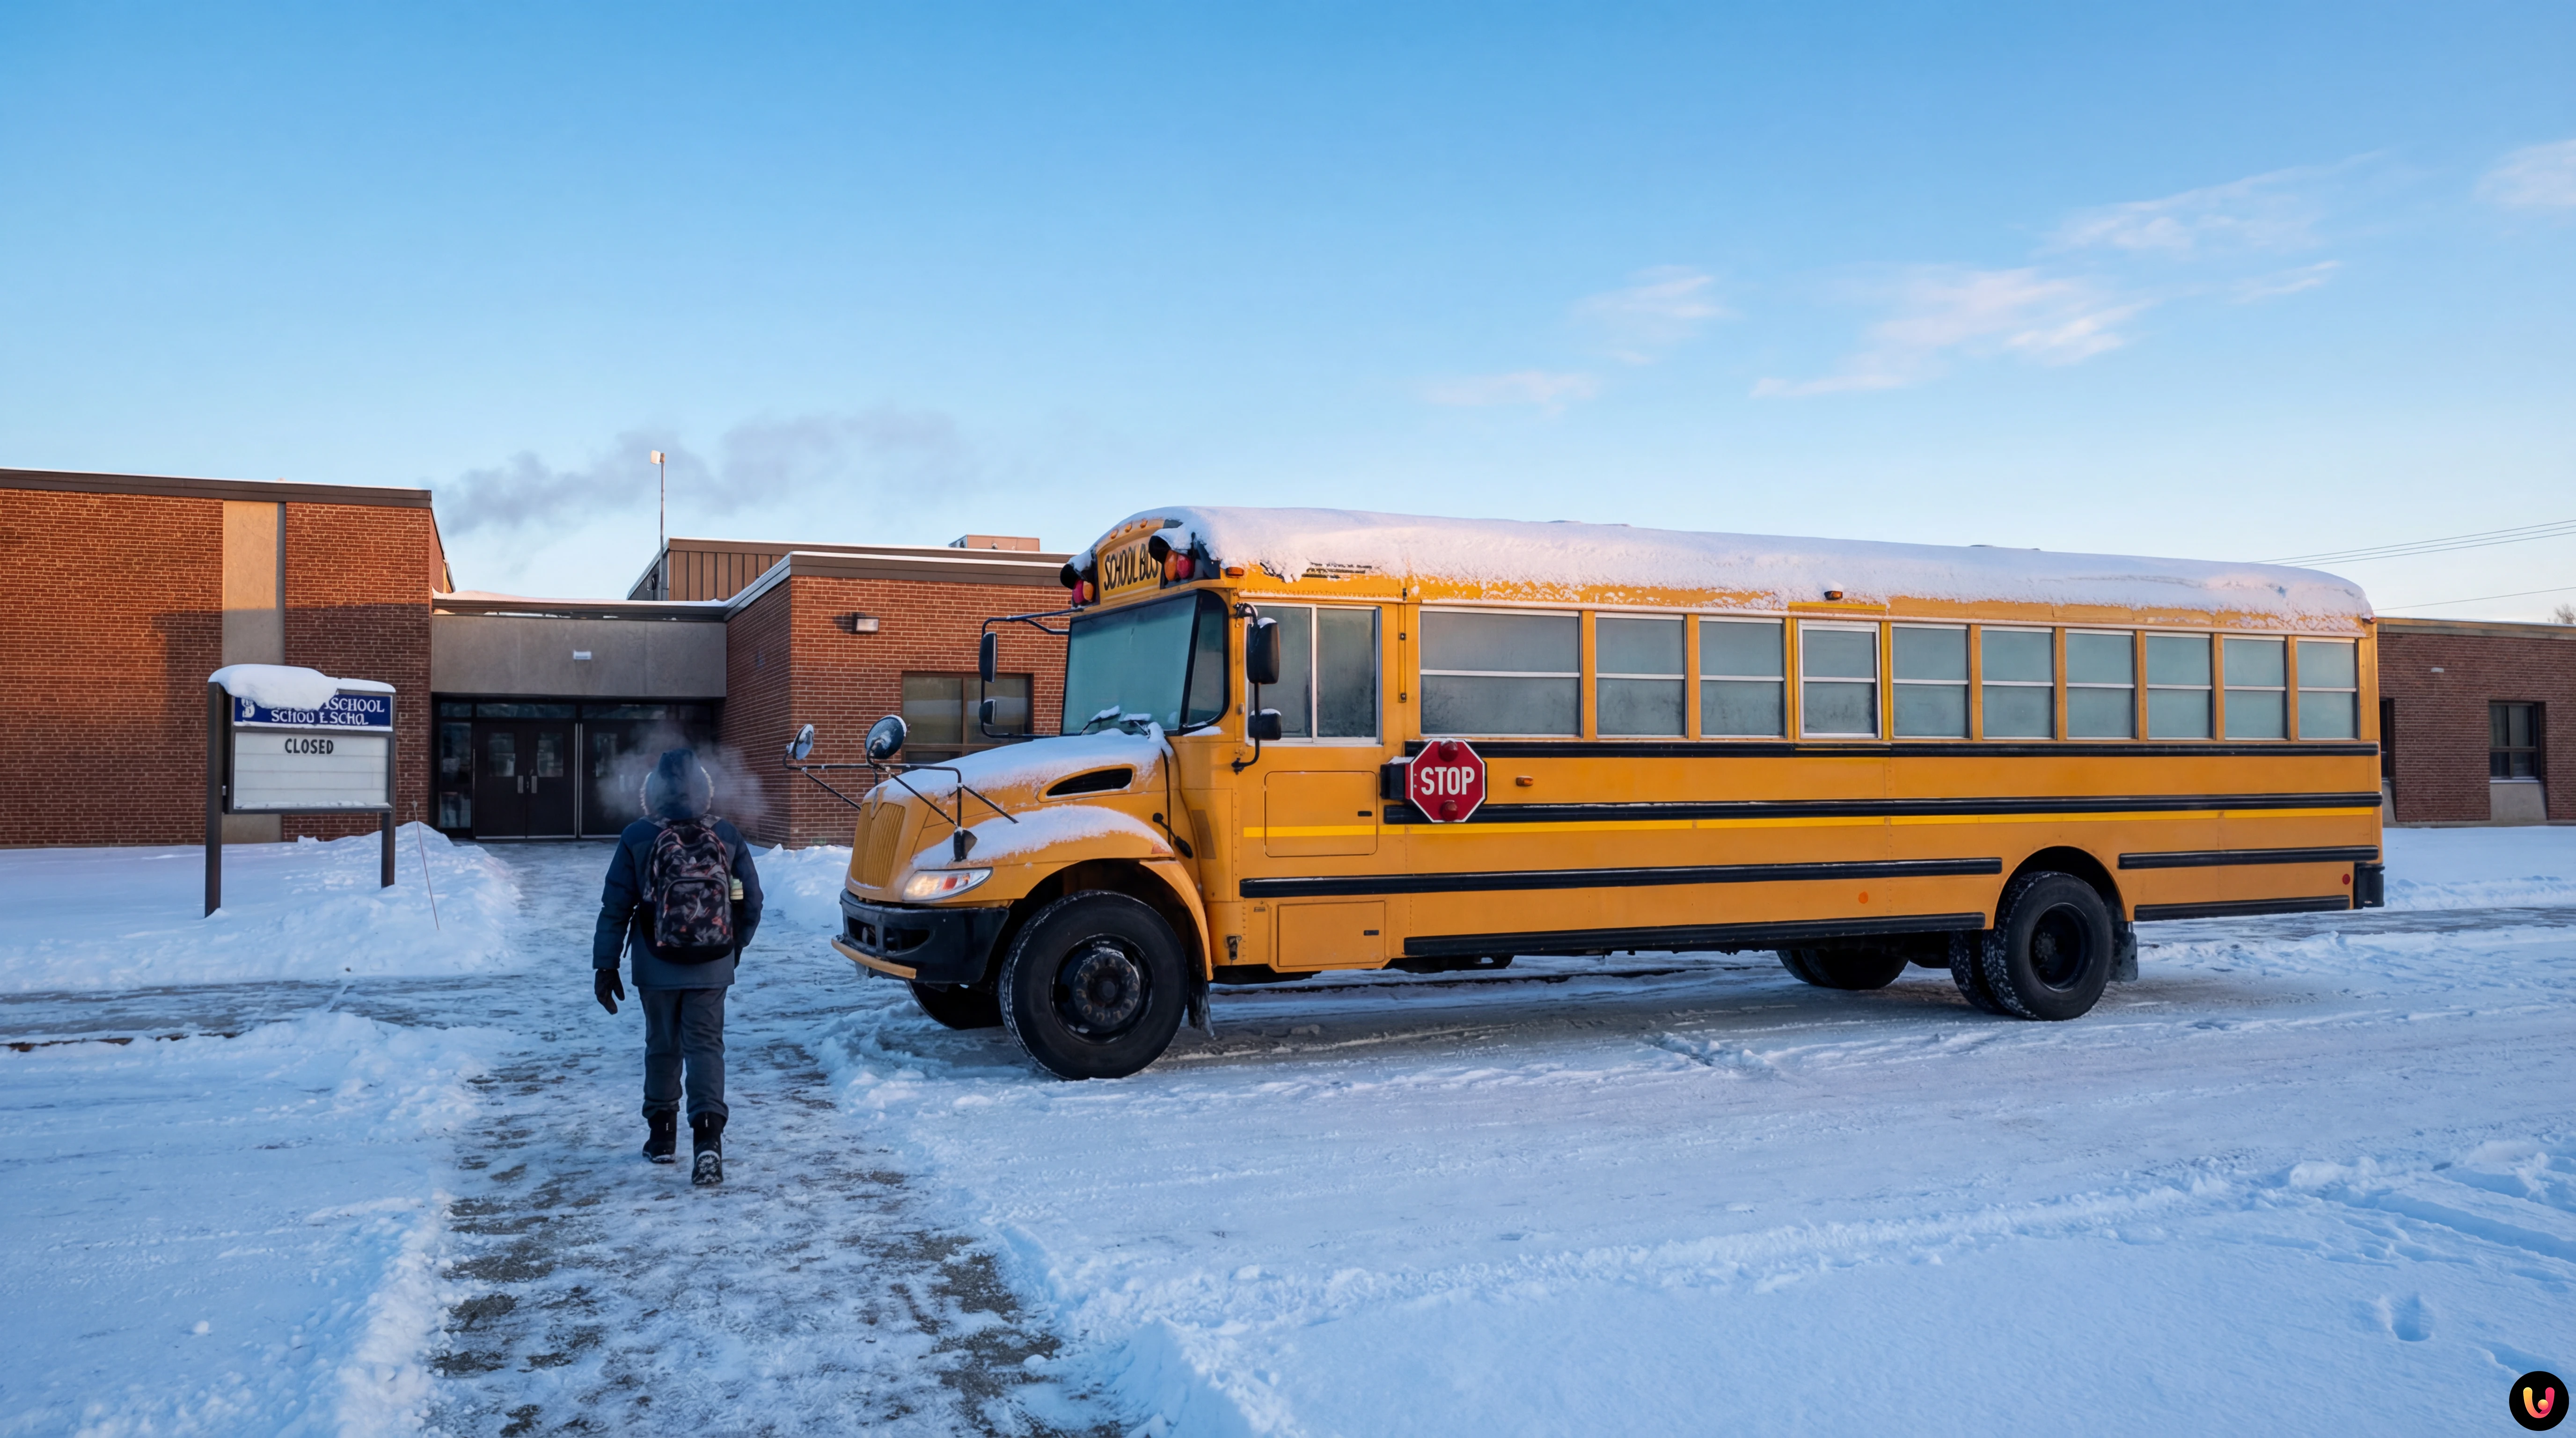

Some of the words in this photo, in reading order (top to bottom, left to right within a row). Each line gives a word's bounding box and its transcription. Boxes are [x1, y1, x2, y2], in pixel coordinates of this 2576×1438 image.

[1104, 544, 1139, 591] SCHOOL
[285, 738, 334, 754] CLOSED
[1421, 766, 1475, 795] STOP
